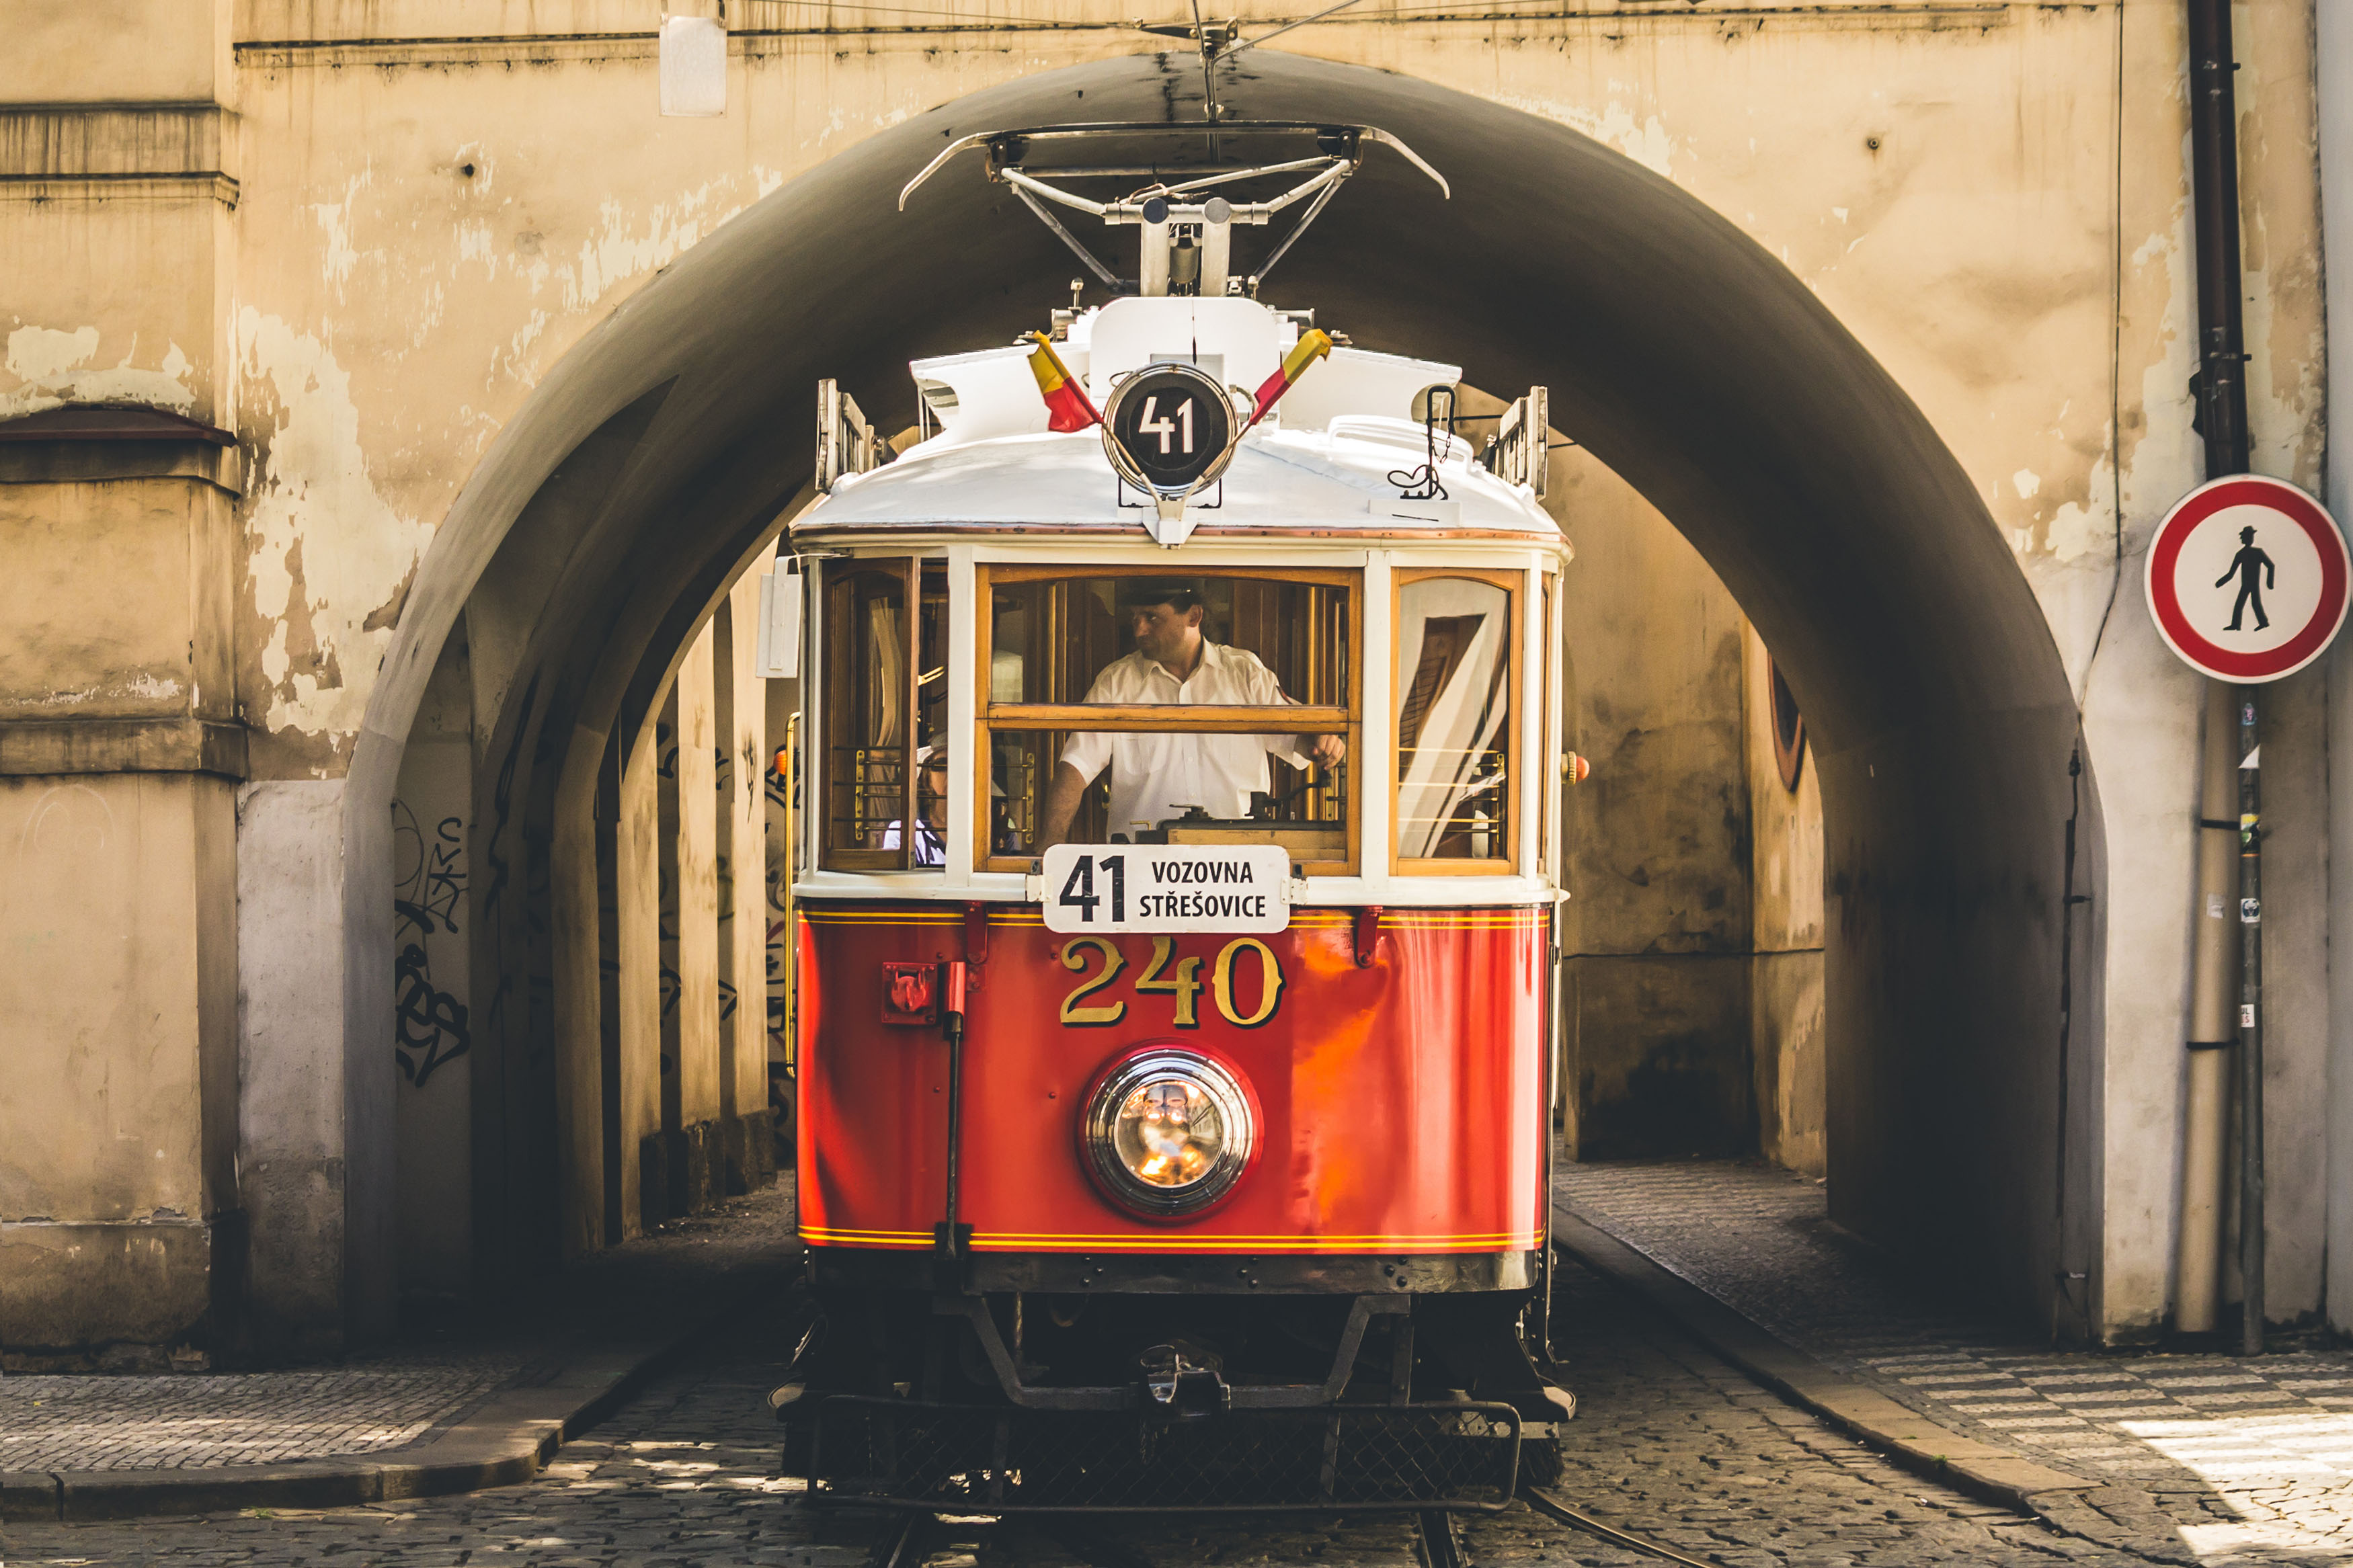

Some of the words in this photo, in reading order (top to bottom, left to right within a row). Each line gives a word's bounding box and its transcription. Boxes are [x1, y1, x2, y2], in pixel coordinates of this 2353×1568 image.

[1139, 397, 1193, 454] 41
[1060, 856, 1125, 922] 41
[1152, 861, 1253, 883] VOZOVNA
[1140, 891, 1266, 917] STŘEŠOVICE
[1060, 936, 1284, 1028] 240
